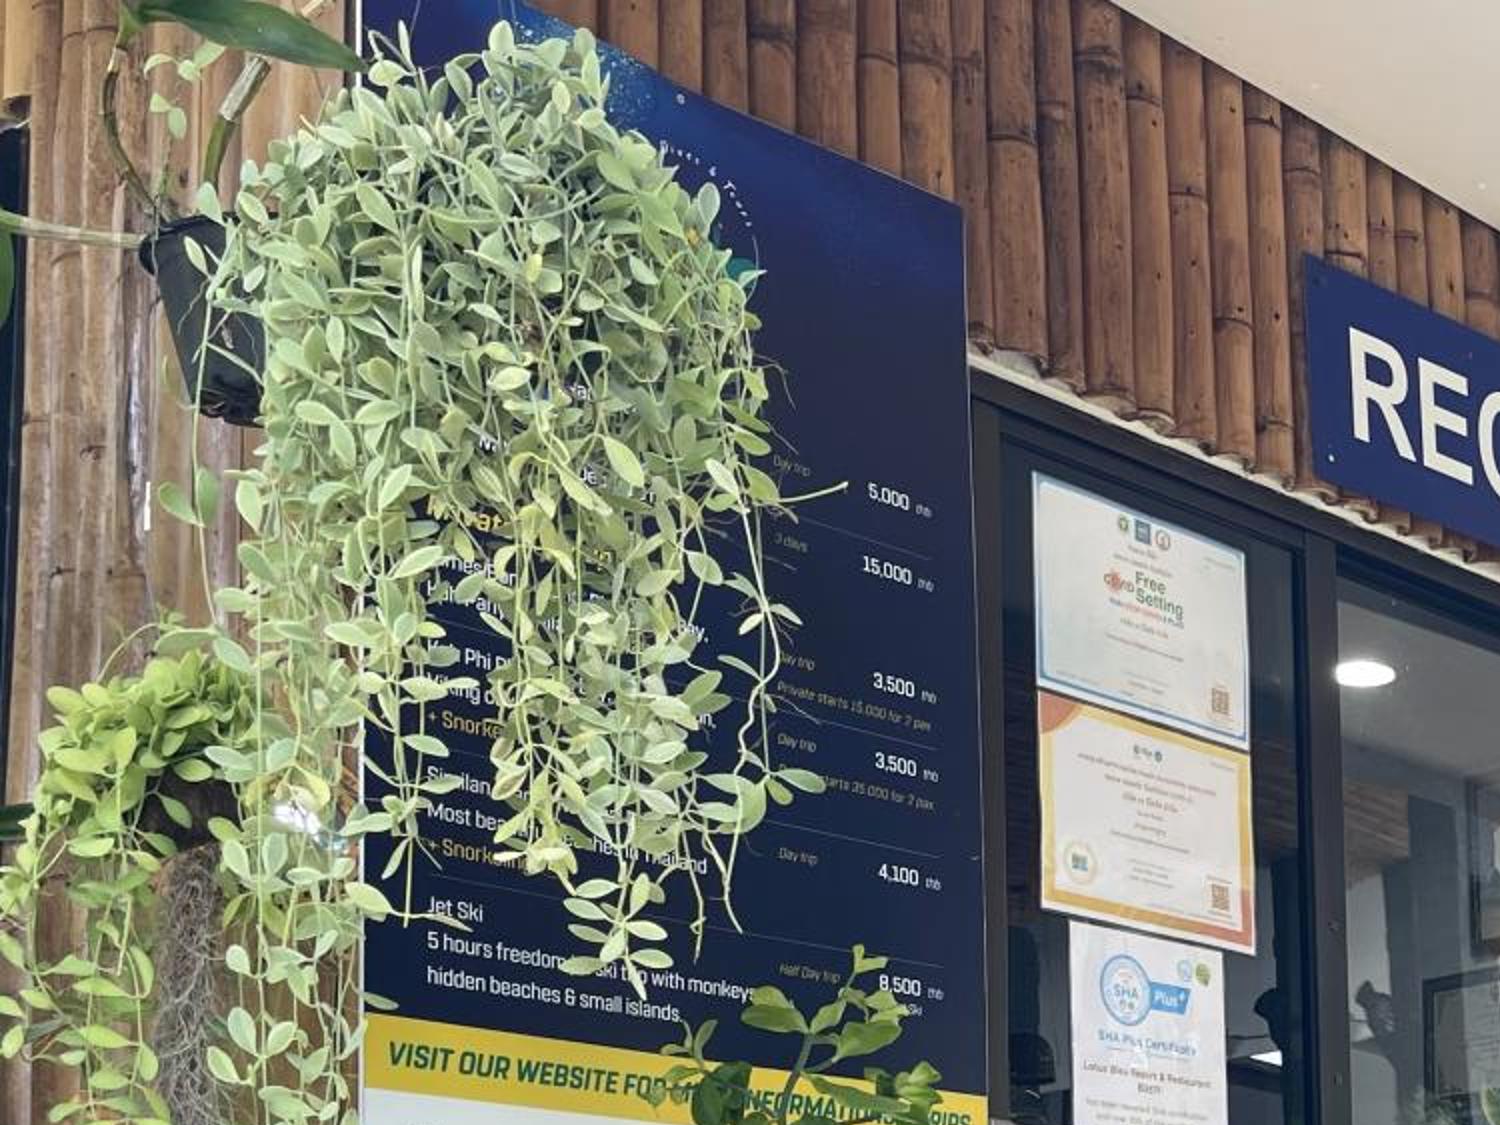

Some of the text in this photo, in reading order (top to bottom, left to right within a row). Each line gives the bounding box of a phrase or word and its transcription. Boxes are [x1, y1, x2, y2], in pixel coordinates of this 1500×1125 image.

[1135, 571, 1167, 595] Free
[465, 648, 492, 671] Phi
[442, 709, 501, 738] Snorke
[427, 765, 491, 796] Siilan
[427, 801, 472, 827] Most
[427, 896, 483, 922] Jet Ski
[427, 931, 439, 950] 5
[443, 933, 494, 959] hours
[497, 940, 564, 970] freedom
[651, 971, 685, 991] with
[427, 966, 487, 993] hidden
[490, 974, 561, 1005] beaches
[565, 988, 576, 1006] &
[579, 992, 623, 1014] small
[389, 1041, 455, 1072] VISIT
[459, 1051, 511, 1080] OUR
[517, 1058, 620, 1095] WEBSITE
